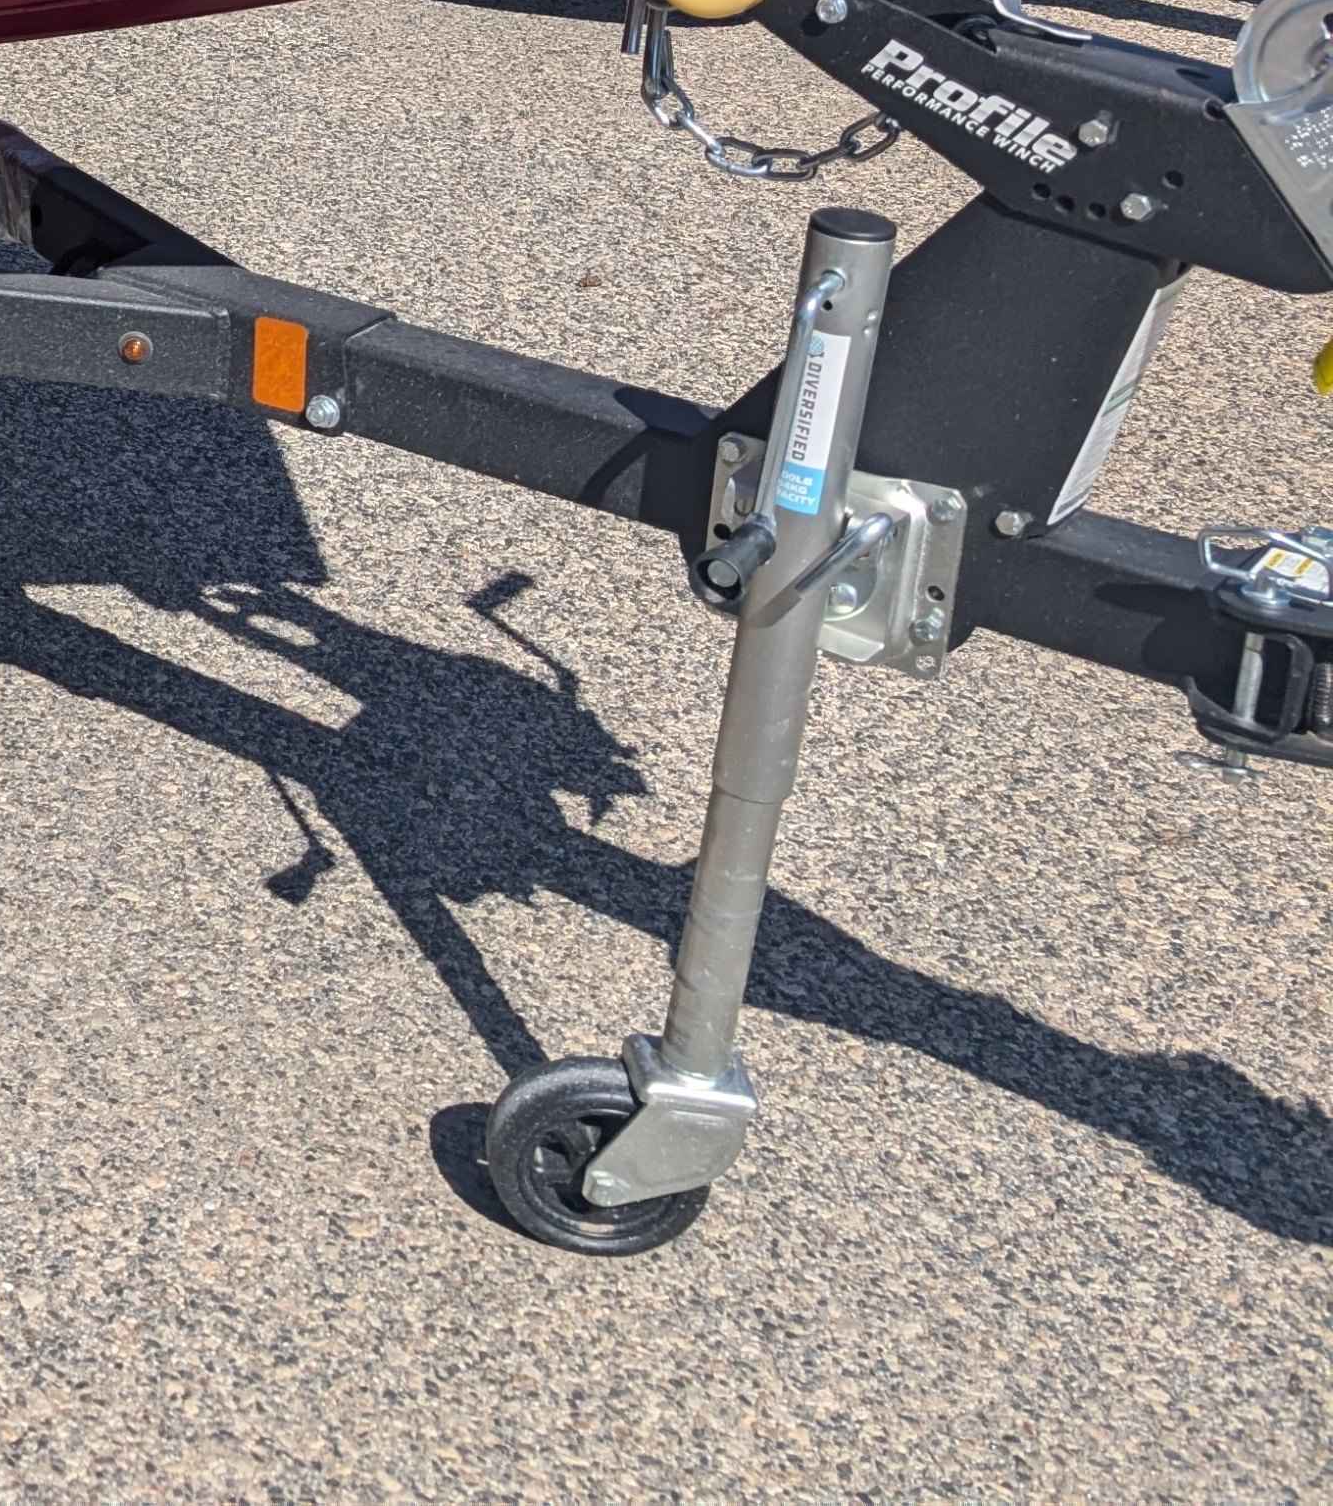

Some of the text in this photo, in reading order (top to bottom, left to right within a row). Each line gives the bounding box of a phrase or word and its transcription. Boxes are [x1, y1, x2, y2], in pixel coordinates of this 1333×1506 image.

[860, 62, 1058, 175] PERFORMANCE WINCH
[868, 38, 1079, 168] Profile
[791, 361, 823, 462] DIVERSIFIED
